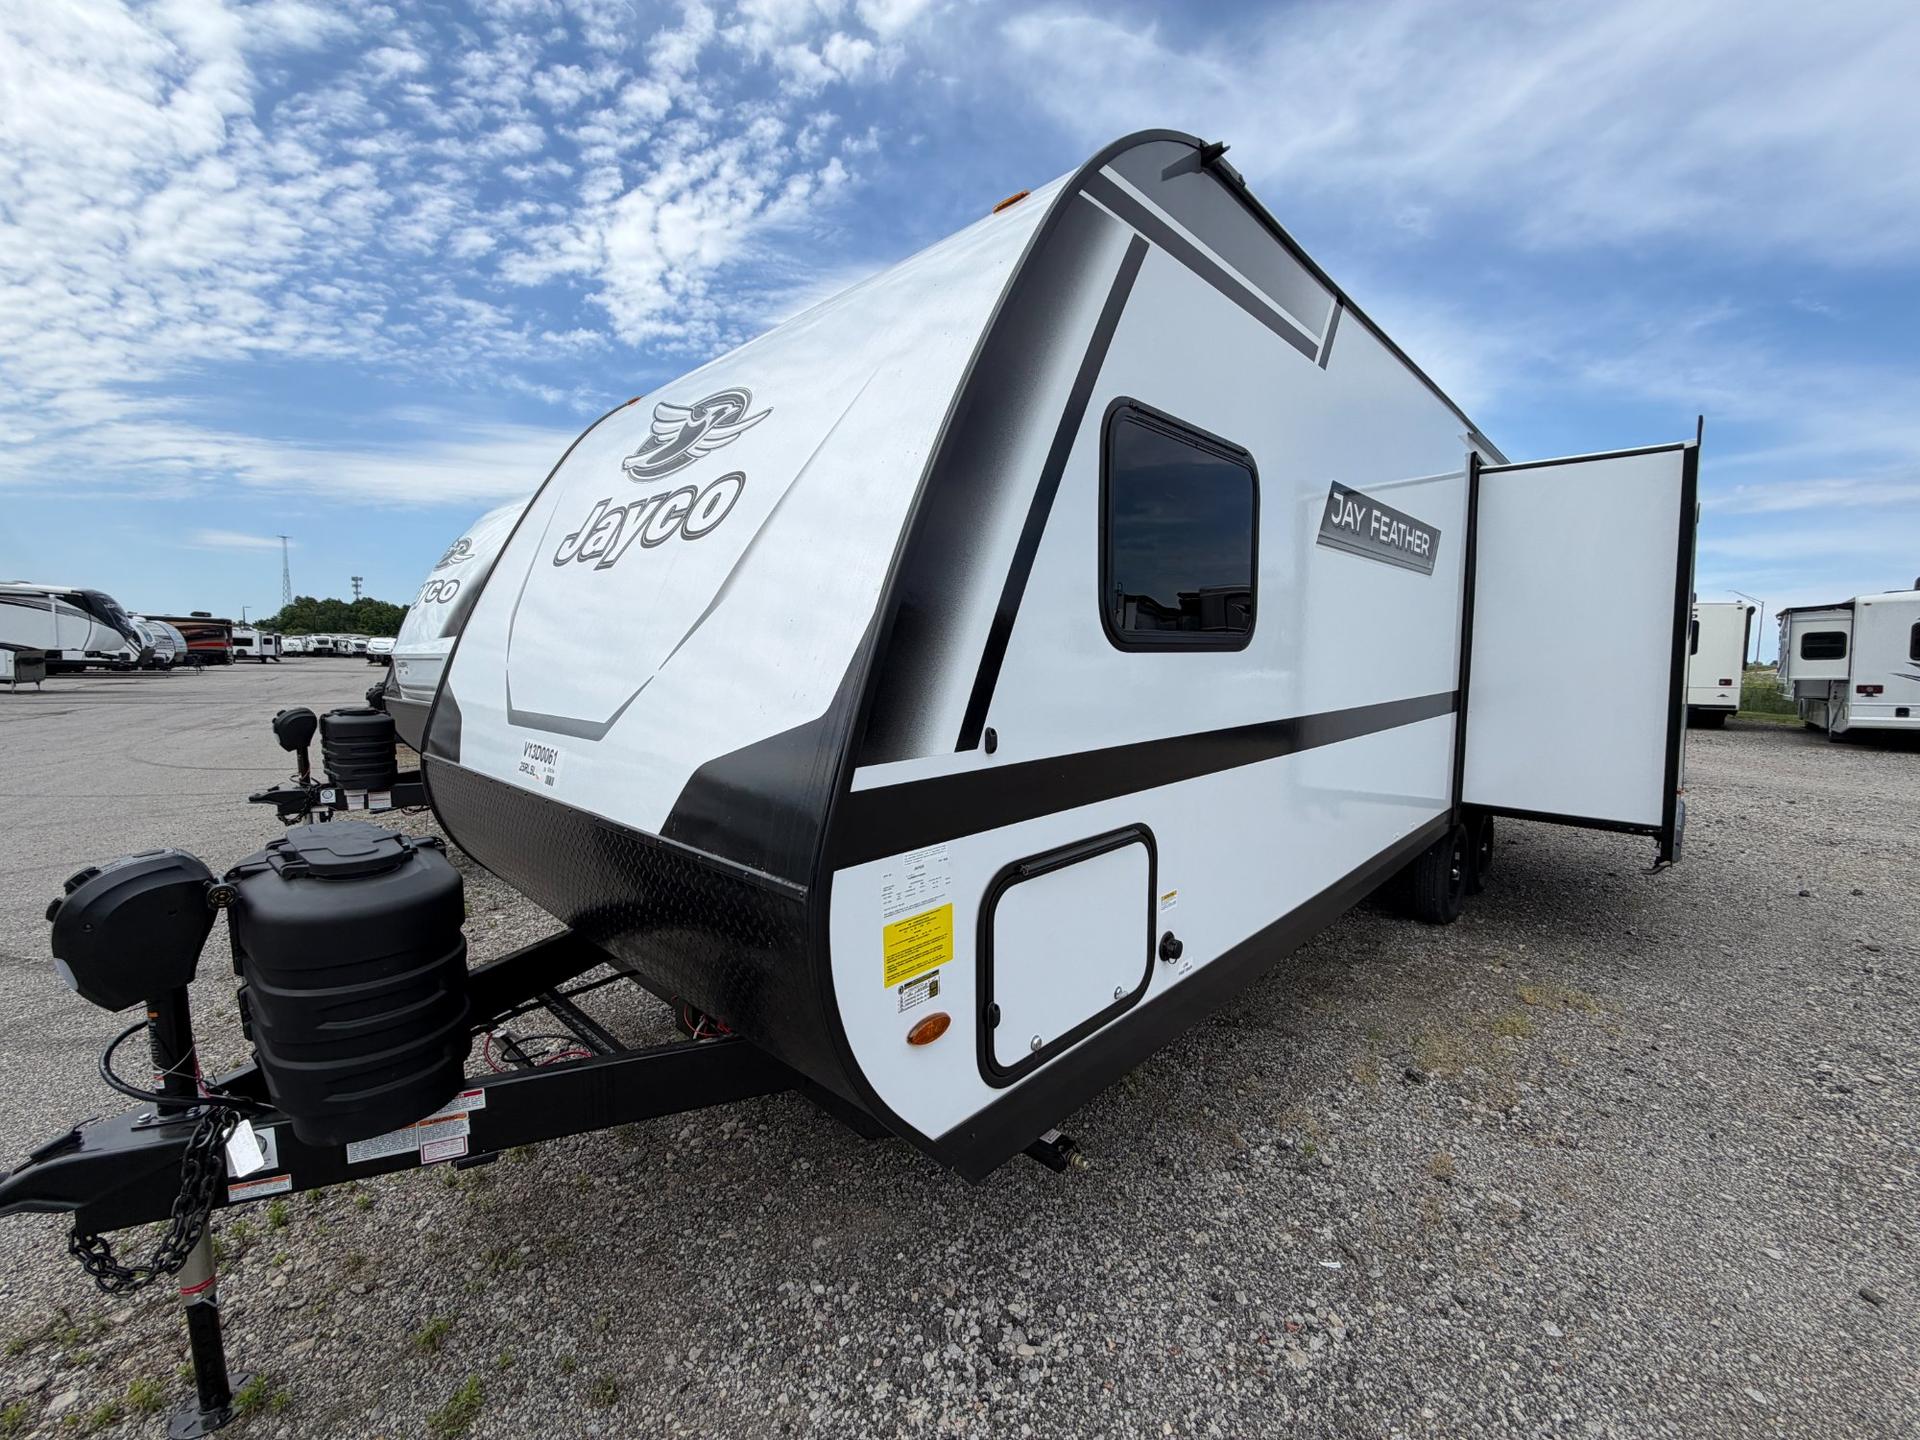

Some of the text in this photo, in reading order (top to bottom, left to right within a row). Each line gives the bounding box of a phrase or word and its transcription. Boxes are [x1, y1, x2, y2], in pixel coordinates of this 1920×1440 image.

[553, 471, 746, 571] Jayco
[1331, 491, 1430, 556] JAY FEATHER
